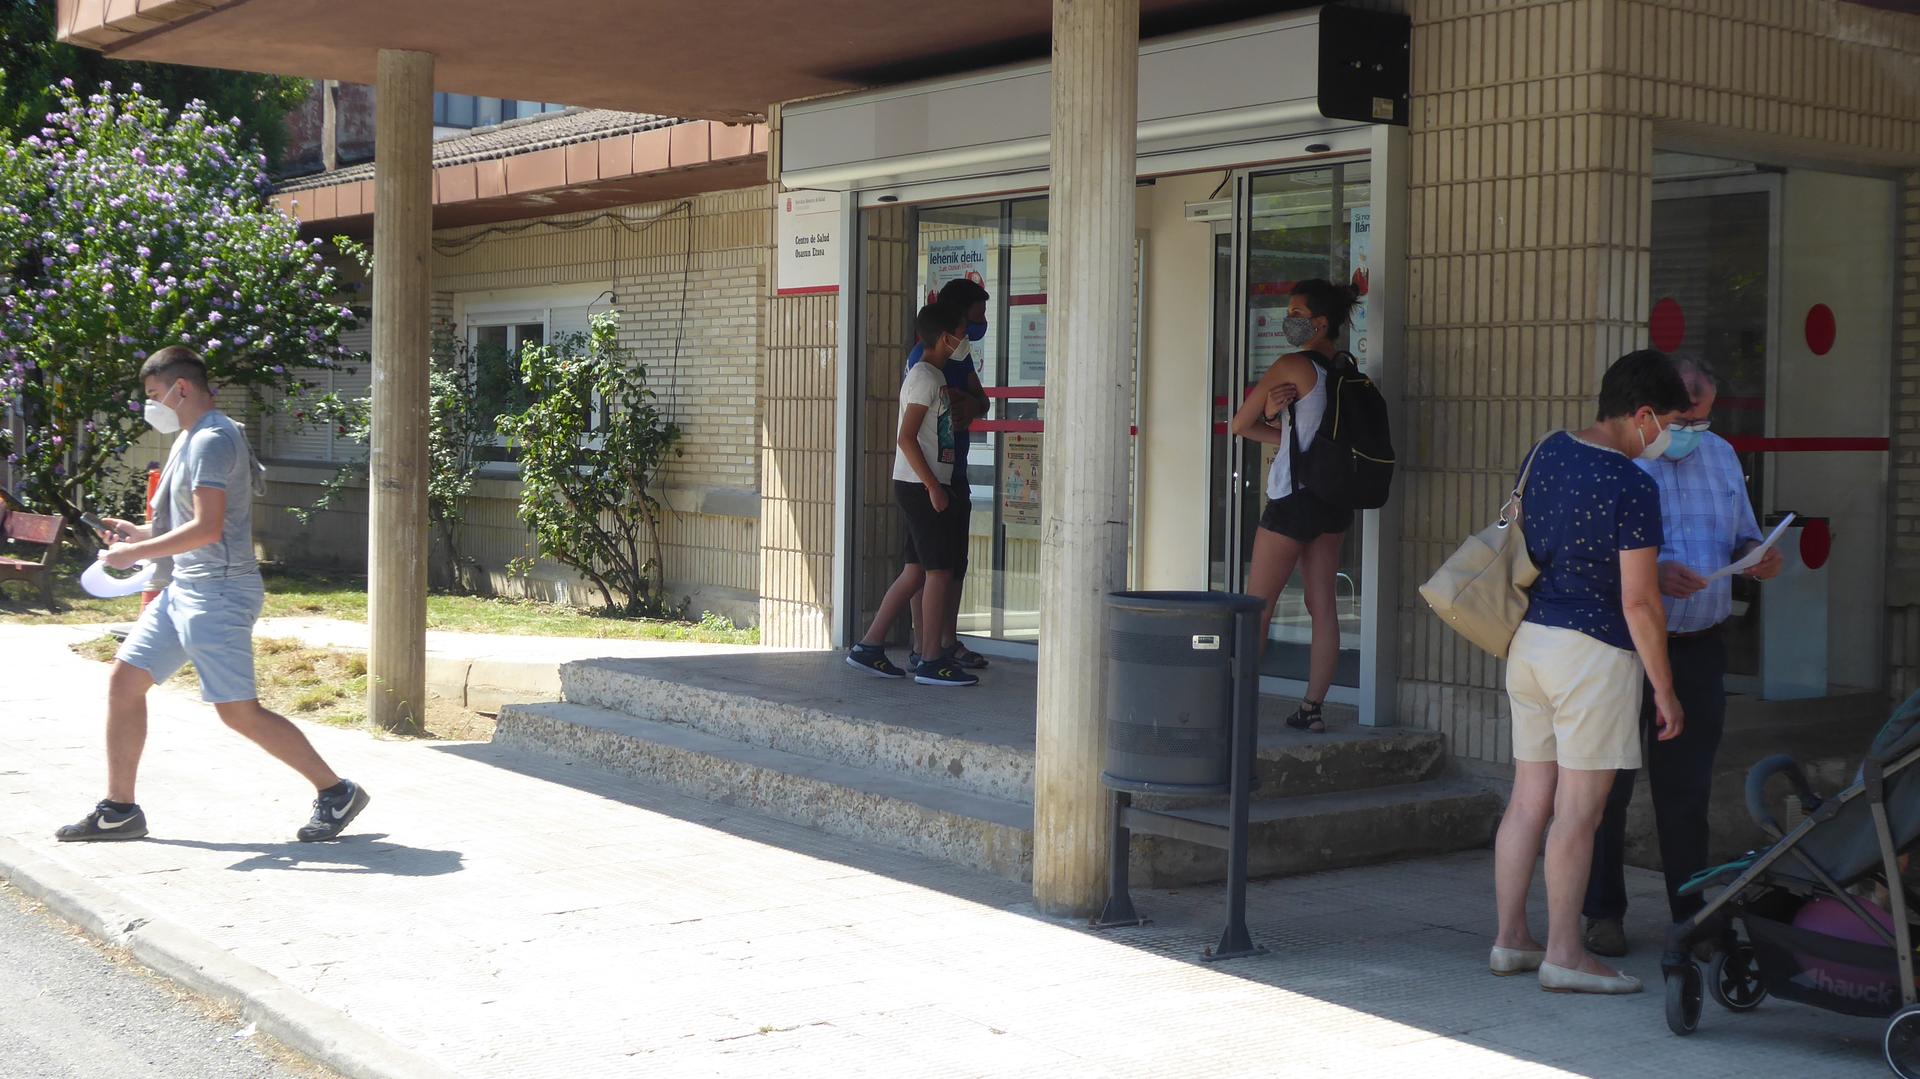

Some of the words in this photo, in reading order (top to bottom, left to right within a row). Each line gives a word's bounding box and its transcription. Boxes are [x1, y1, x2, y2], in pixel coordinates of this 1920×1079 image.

[795, 235, 809, 245] Centro
[810, 234, 816, 243] de
[817, 232, 830, 242] Salud
[929, 251, 959, 265] lehenik
[960, 249, 984, 263] deitu.
[1819, 968, 1893, 1005] hauck
